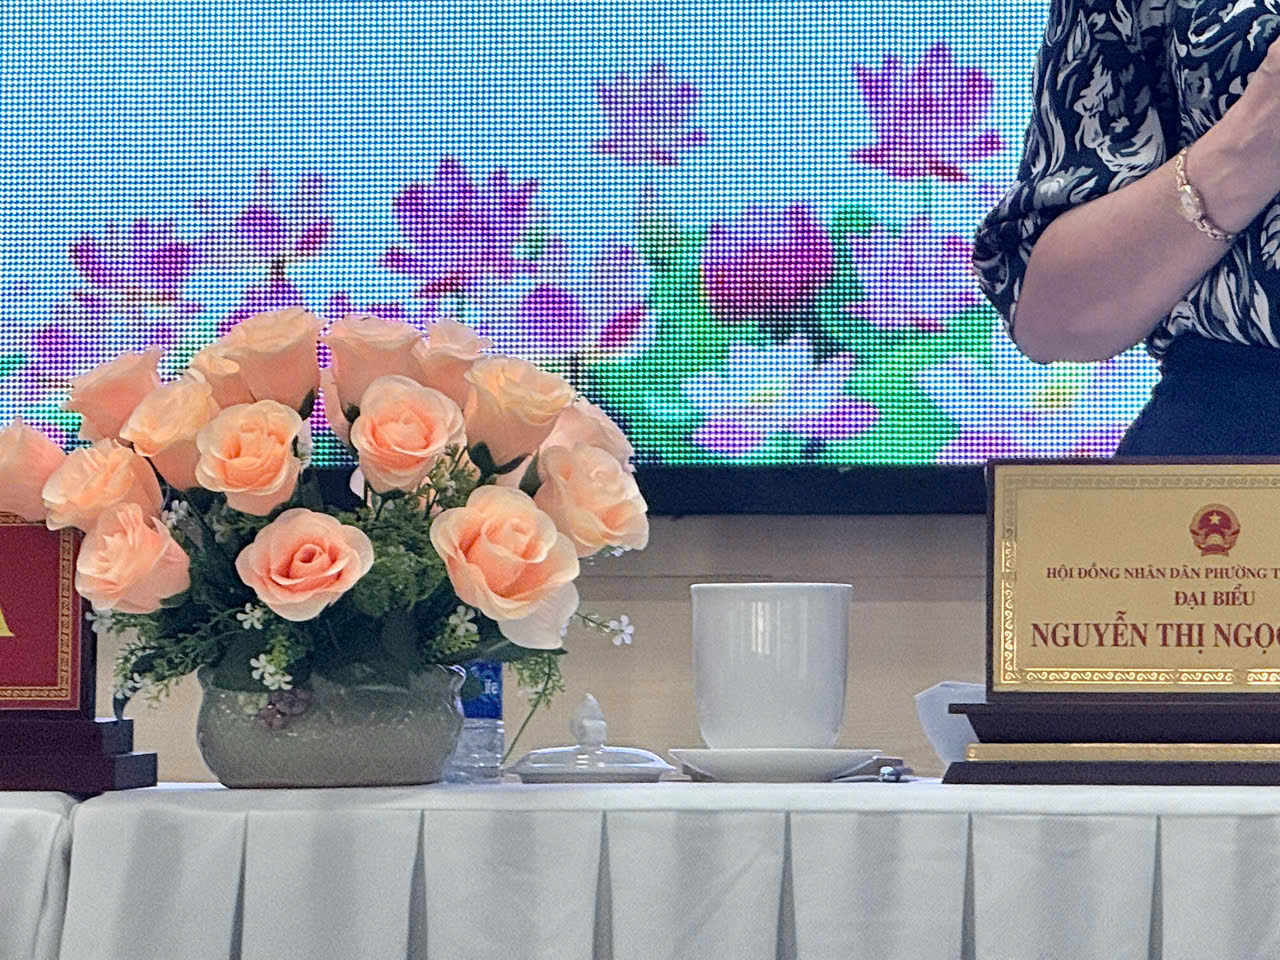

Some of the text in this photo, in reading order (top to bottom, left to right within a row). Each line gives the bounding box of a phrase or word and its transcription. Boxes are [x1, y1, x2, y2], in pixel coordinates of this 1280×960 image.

[1046, 564, 1073, 581] HỘI
[1077, 561, 1120, 579] ĐỒNG
[1124, 564, 1166, 579] NHÂN
[1170, 565, 1200, 579] DÂN
[1205, 565, 1267, 579] PHƯỜNG
[1174, 584, 1255, 610] ĐẠI BIỂU
[1031, 610, 1148, 648] NGUYỄN
[1156, 623, 1205, 655] THỊ
